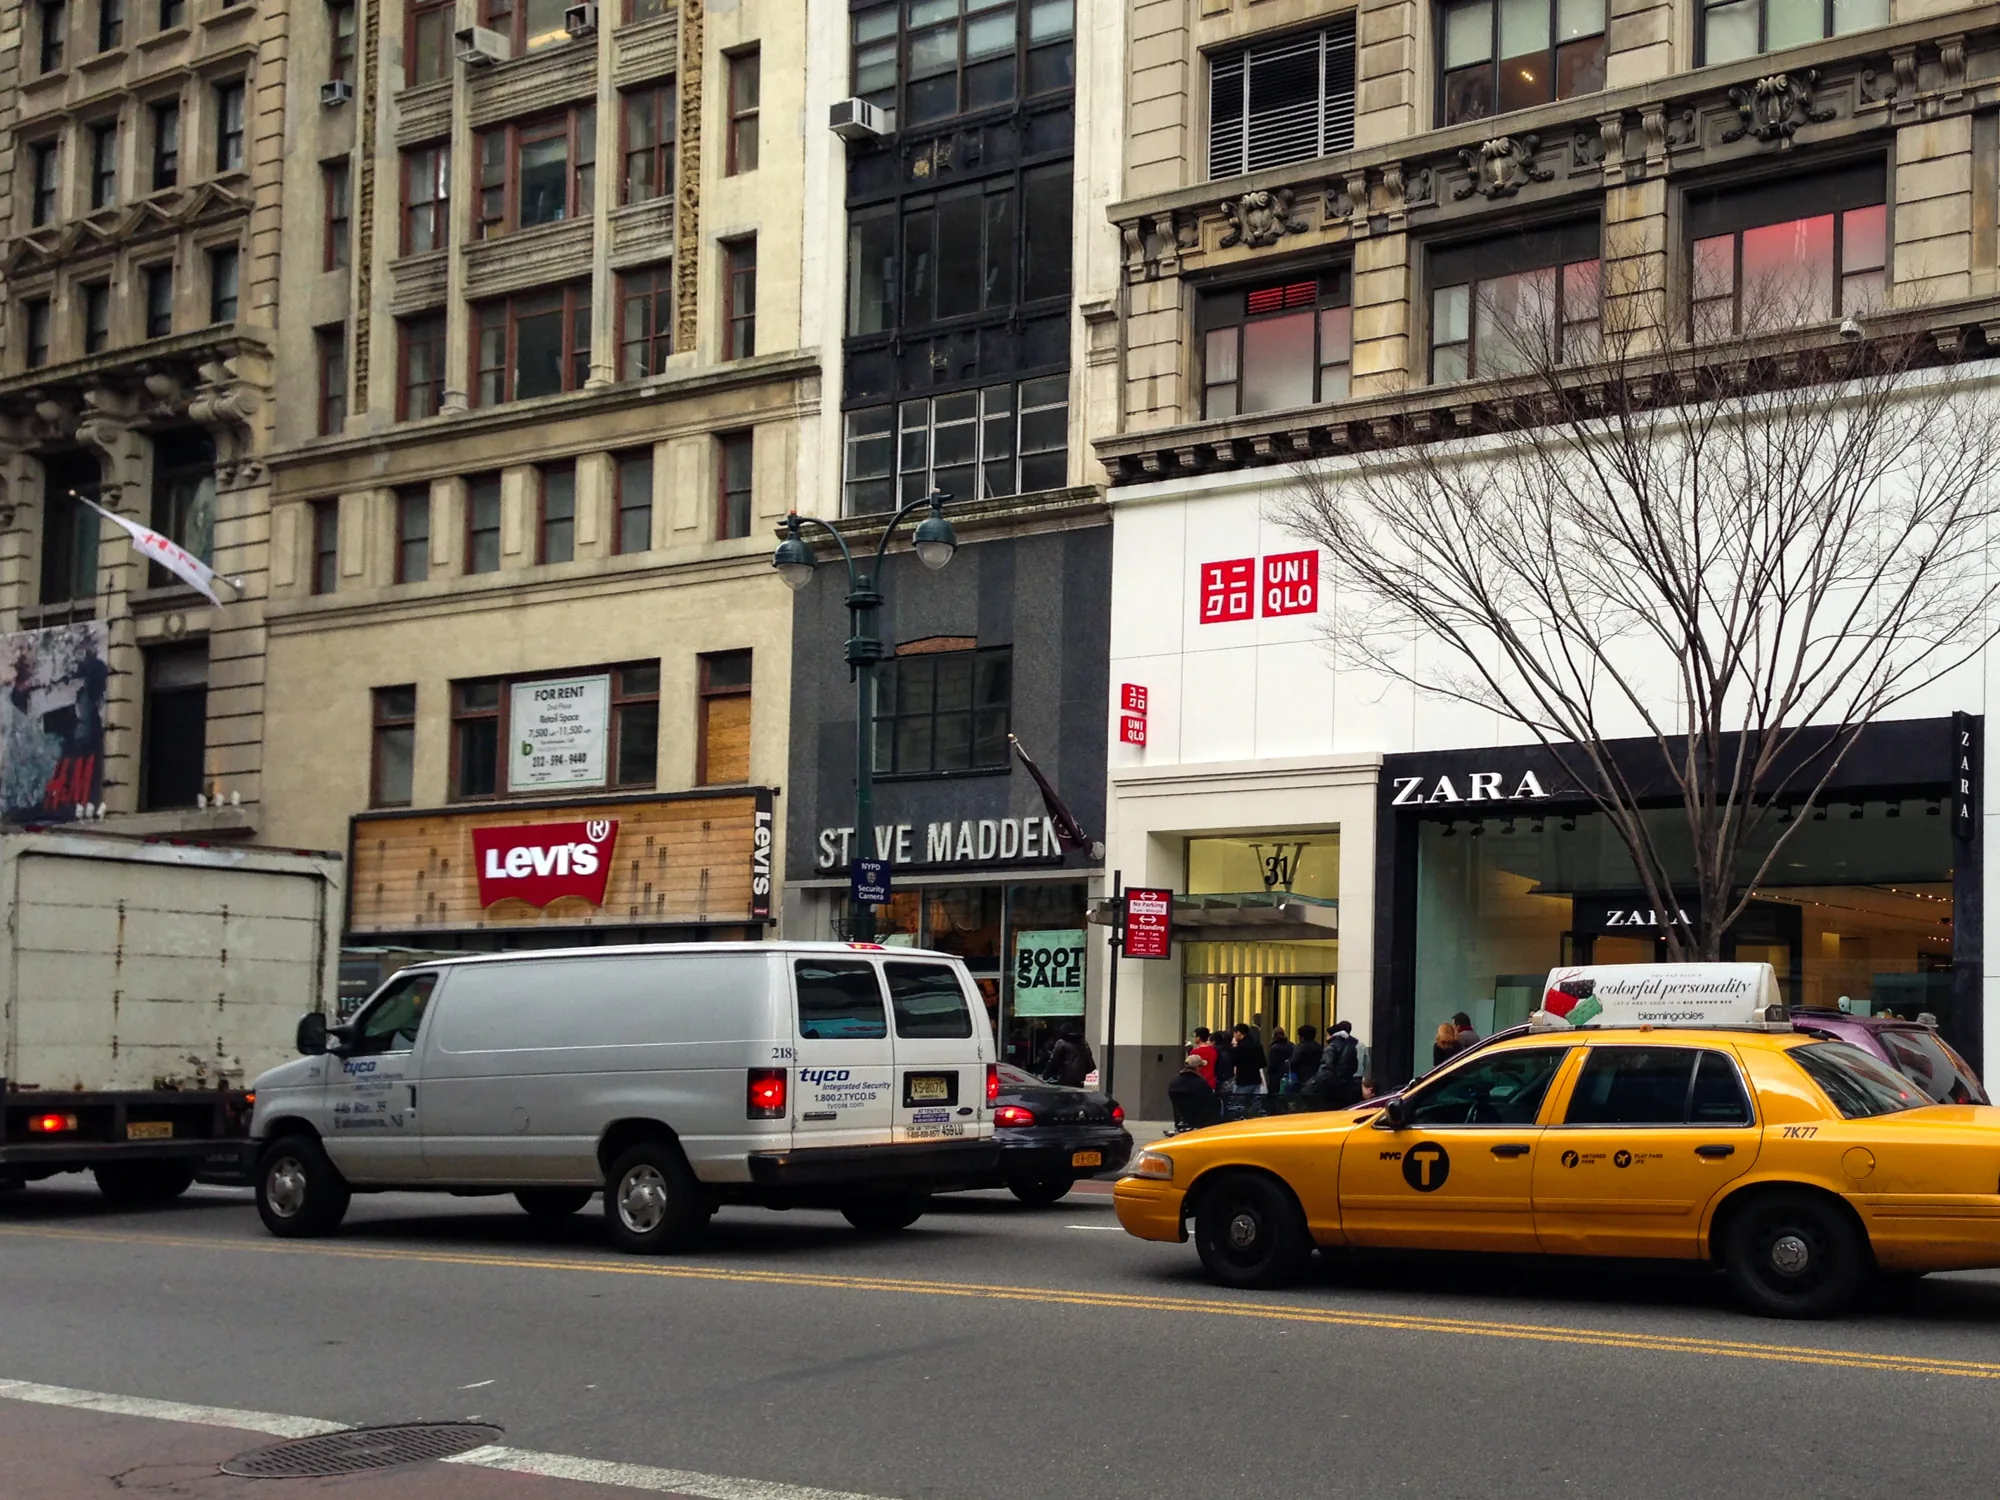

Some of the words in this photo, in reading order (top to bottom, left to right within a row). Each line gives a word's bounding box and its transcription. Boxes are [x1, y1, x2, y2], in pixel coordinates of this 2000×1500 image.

[1268, 558, 1309, 584] UNI
[1268, 584, 1312, 613] QLO
[535, 688, 557, 701] FOR
[558, 686, 585, 700] RENT
[540, 713, 558, 724] Retail
[559, 712, 579, 724] Space
[1128, 719, 1144, 731] UNI
[528, 728, 548, 739] 7,500
[1127, 729, 1145, 741] QLO
[1960, 730, 1970, 819] ZARA
[1391, 769, 1551, 806] ZARA
[819, 825, 912, 868] STVE
[926, 816, 1062, 862] MADDEN
[485, 842, 599, 878] Levi's
[861, 862, 881, 871] NYPD
[1248, 842, 1311, 893] W
[1264, 855, 1292, 886] 31
[857, 885, 885, 894] Security
[858, 892, 884, 901] Camera
[1139, 924, 1165, 932] Standing
[1018, 947, 1085, 968] BOOT
[1016, 967, 1081, 989] SALE
[1599, 978, 1662, 1000] colorful
[1660, 977, 1752, 999] personality
[771, 1047, 792, 1059] 218
[343, 1061, 377, 1076] tyco
[799, 1067, 850, 1086] tyco
[822, 1082, 861, 1091] Integrated
[862, 1081, 891, 1090] Security
[827, 1101, 865, 1109] tycois.com
[1782, 1127, 1819, 1139] 7K77
[1379, 1151, 1403, 1160] NYC
[1413, 1151, 1440, 1186] T
